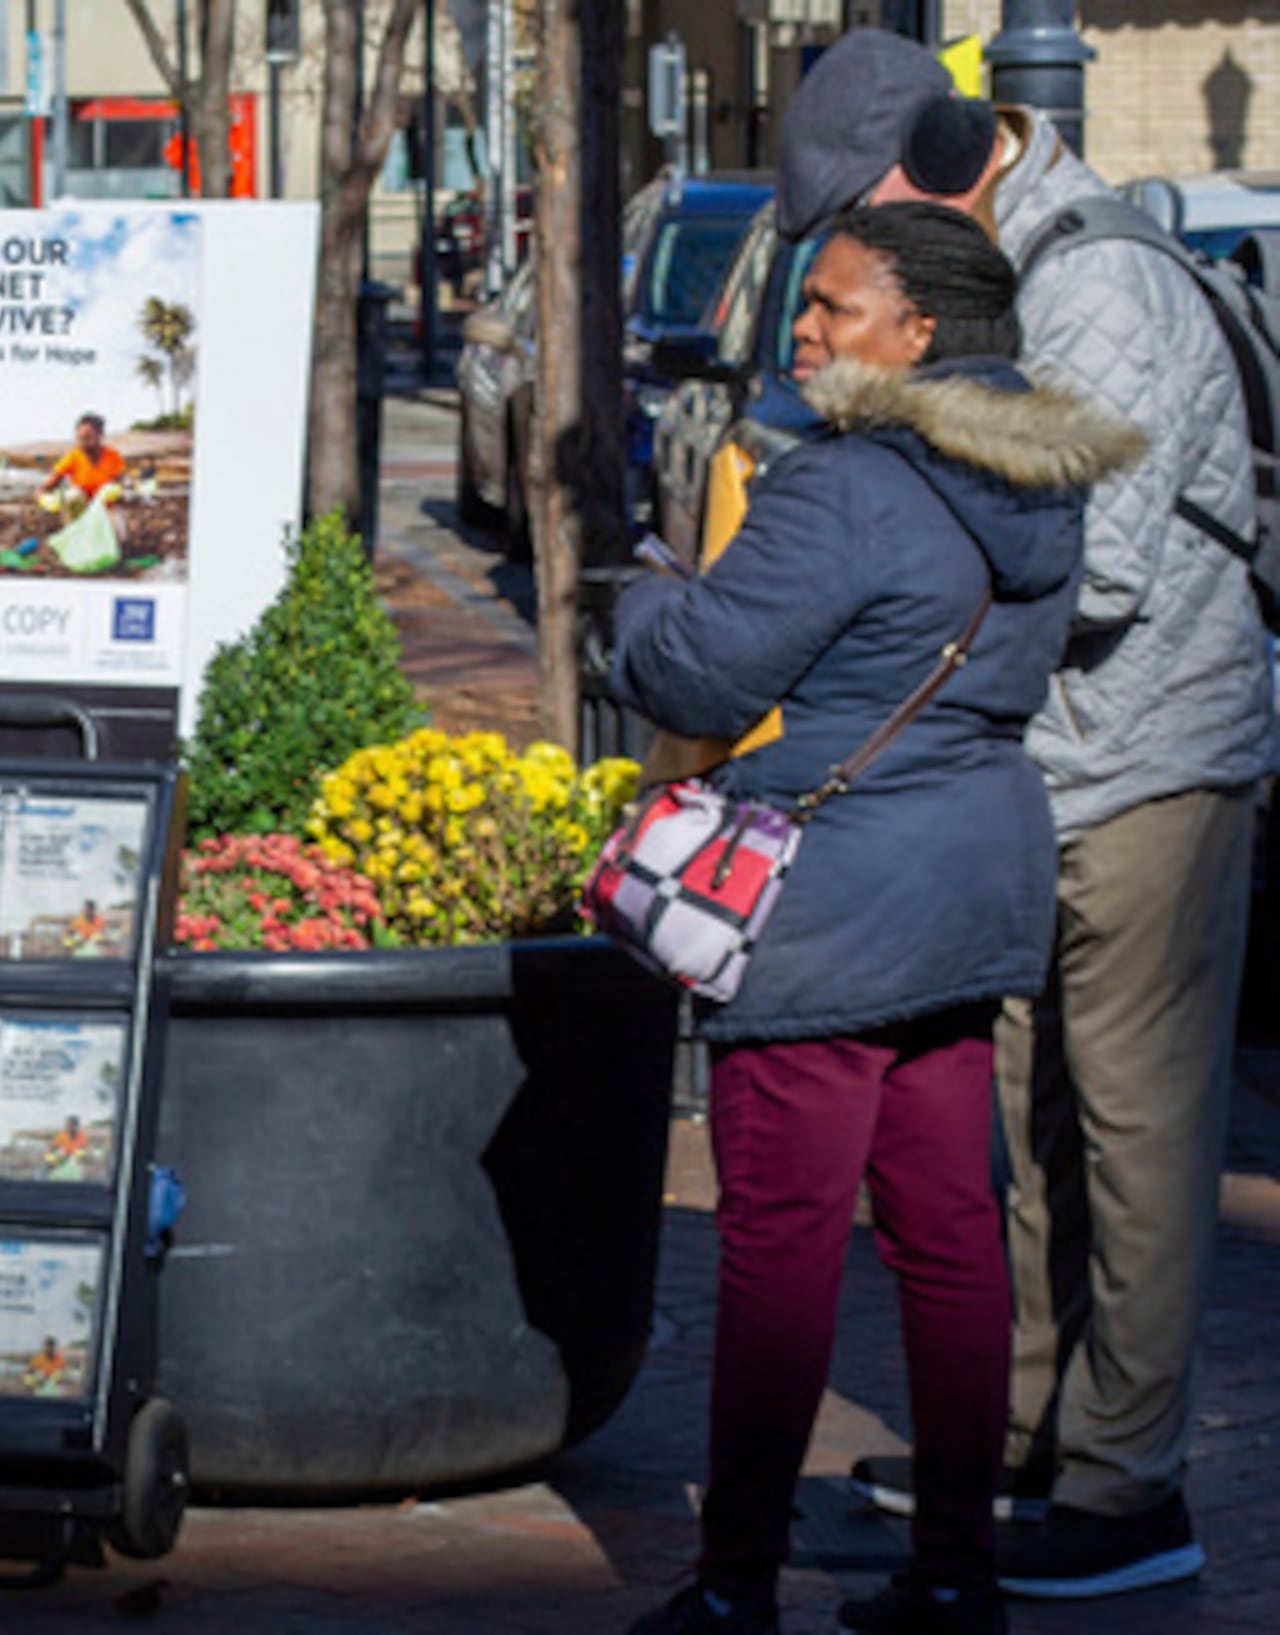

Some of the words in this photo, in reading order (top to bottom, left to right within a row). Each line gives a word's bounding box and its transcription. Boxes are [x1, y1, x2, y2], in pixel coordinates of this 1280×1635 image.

[2, 236, 69, 266] OUR
[11, 343, 40, 362] for
[46, 345, 97, 366] Hope
[3, 605, 71, 636] COPY
